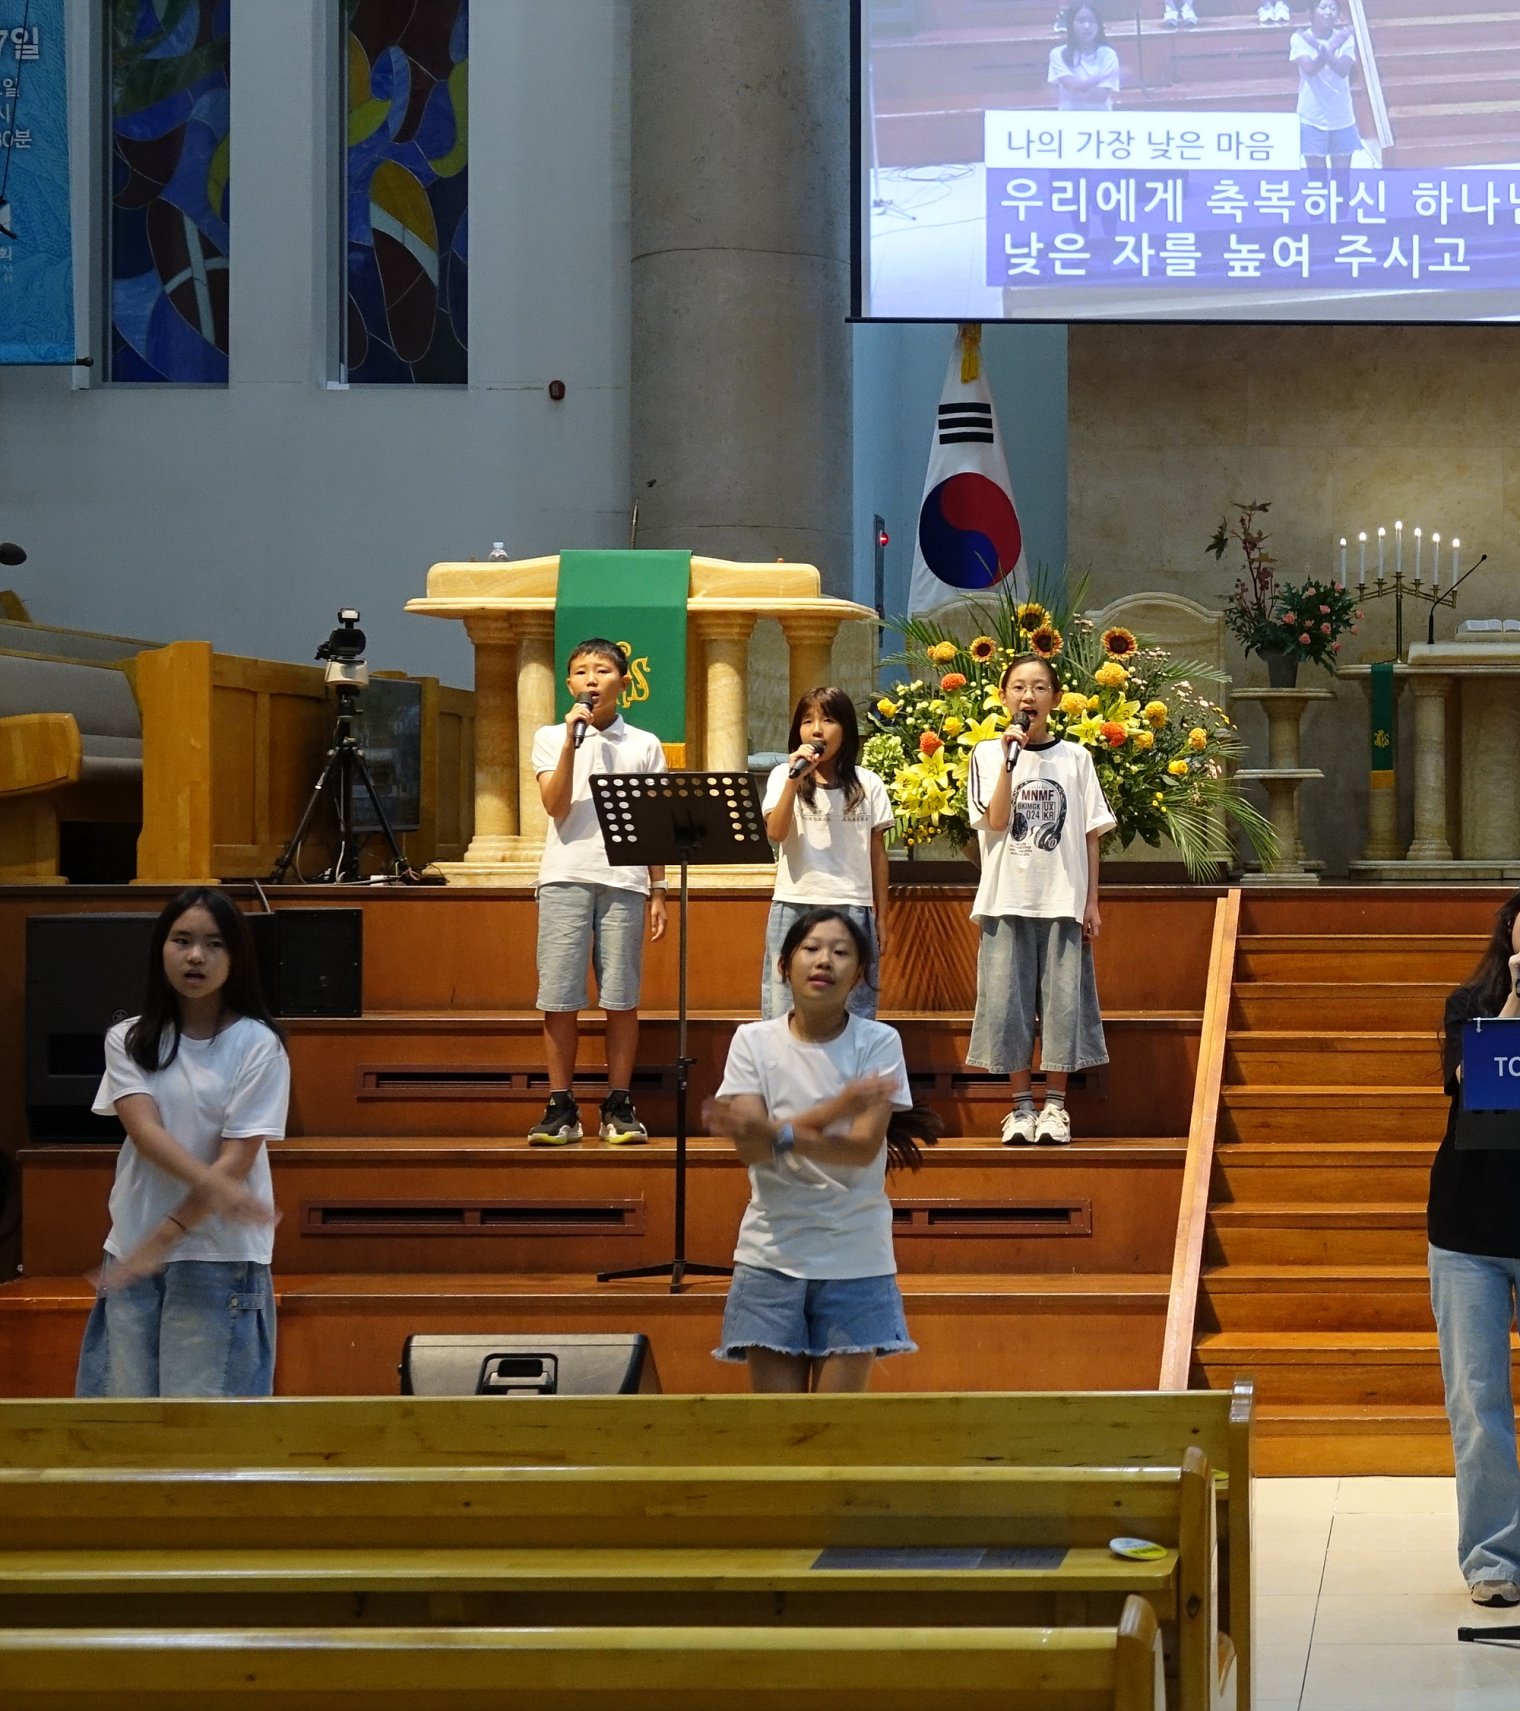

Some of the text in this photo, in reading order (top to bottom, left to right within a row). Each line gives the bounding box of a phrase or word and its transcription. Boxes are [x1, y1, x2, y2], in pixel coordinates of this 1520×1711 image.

[1006, 129, 1274, 162] 나의 가장 낮은 마음
[1001, 177, 1184, 224] 우리에게
[1206, 180, 1387, 226] 축복하신
[1004, 232, 1472, 280] 낮은 자를 높여 주시고
[1021, 789, 1055, 801] MNMF
